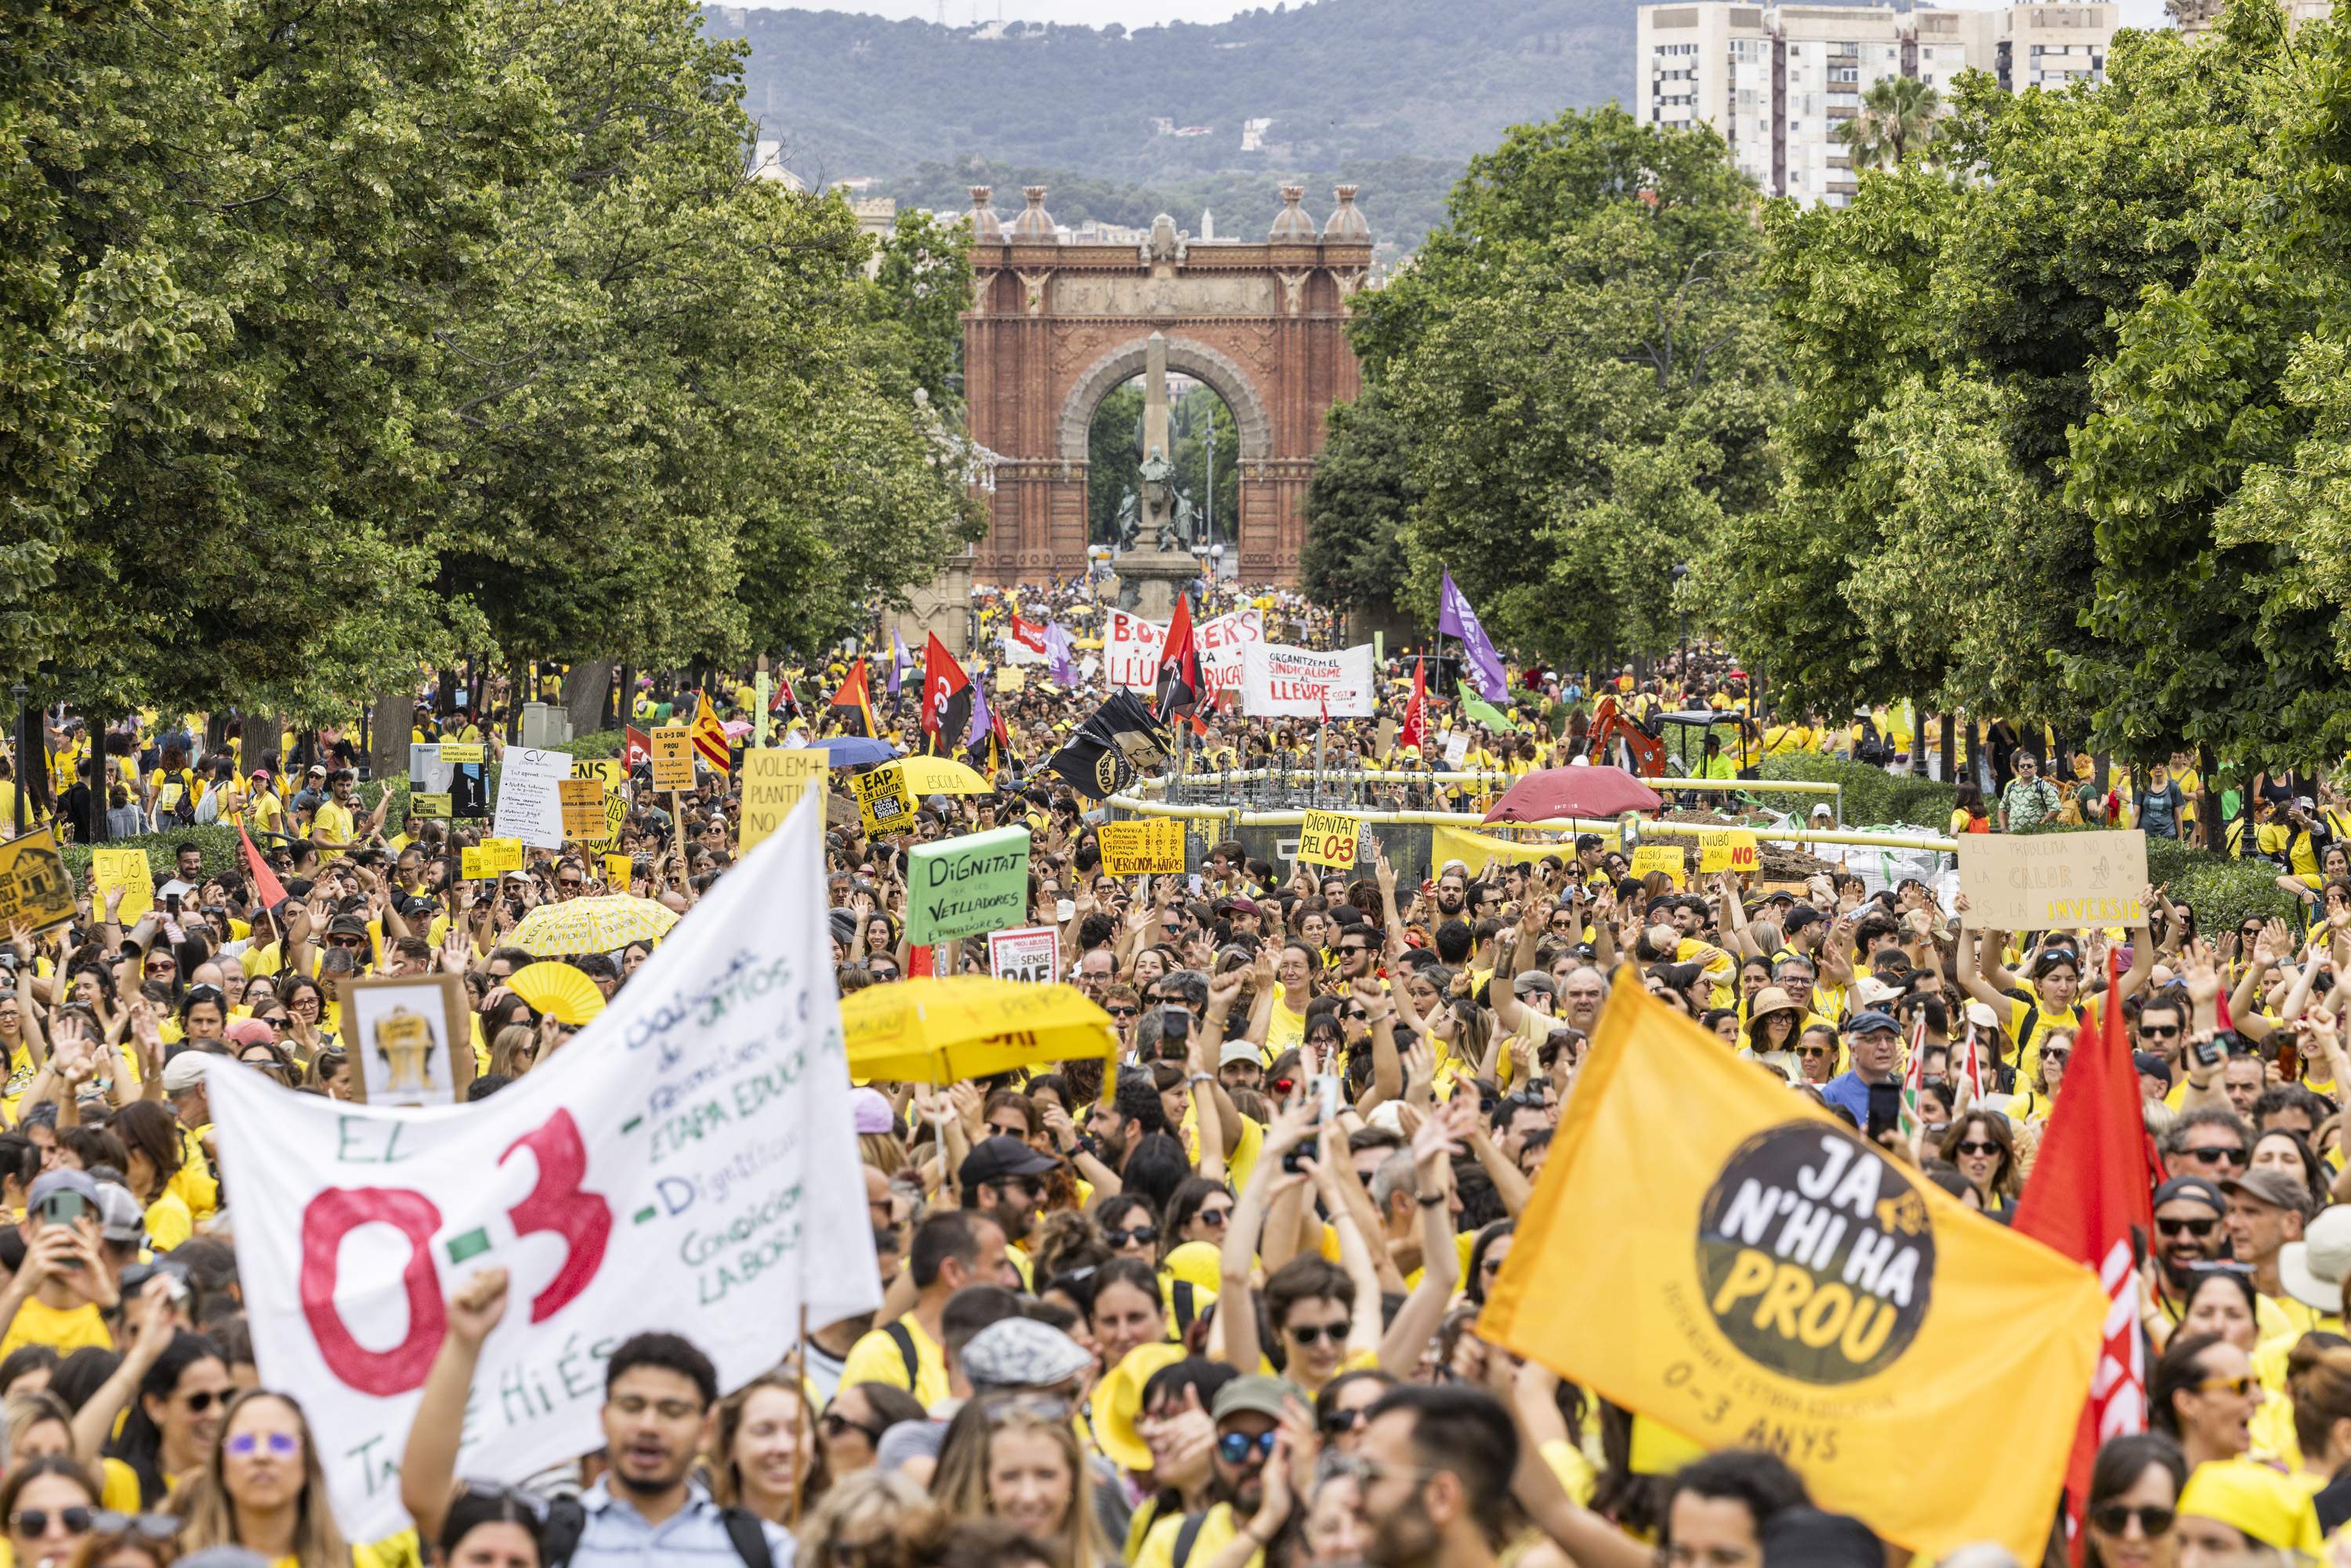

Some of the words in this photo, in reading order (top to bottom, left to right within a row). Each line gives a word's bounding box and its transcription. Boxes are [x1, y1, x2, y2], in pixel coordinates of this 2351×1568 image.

[1269, 661, 1342, 678] SINDICALISME
[1270, 653, 1326, 667] ORGANITZEM
[1270, 680, 1330, 701] LLEURE
[523, 749, 547, 762] CV
[753, 757, 808, 777] VOLEM
[863, 769, 894, 792] EAP
[926, 774, 965, 789] ESCOLA
[863, 791, 874, 801] EN
[875, 783, 901, 797] LLUITA
[874, 801, 899, 814] ESCOLA
[877, 806, 900, 820] DIGNA
[1301, 835, 1321, 854] PEL
[1324, 835, 1354, 862] 0-3
[1731, 846, 1753, 864] NO
[1972, 839, 1991, 854] EL
[2008, 839, 2069, 856] PROBLEMA
[2084, 839, 2100, 854] NO
[1113, 857, 1153, 871] VERGONYA
[1974, 871, 1991, 885] LA
[2009, 864, 2073, 889] CALOR
[928, 892, 1019, 922] VETLLADORES
[2009, 902, 2028, 919] LA
[1021, 953, 1051, 965] SENSE
[338, 1115, 411, 1164] EL
[1798, 1135, 1883, 1219] JA
[299, 1106, 613, 1396] 0-3
[1719, 1178, 1848, 1272] N'HI
[1842, 1227, 1920, 1308] HA
[1712, 1248, 1898, 1364] PROU
[1662, 1360, 1733, 1425] 0-3
[1741, 1416, 1840, 1462] ANYS
